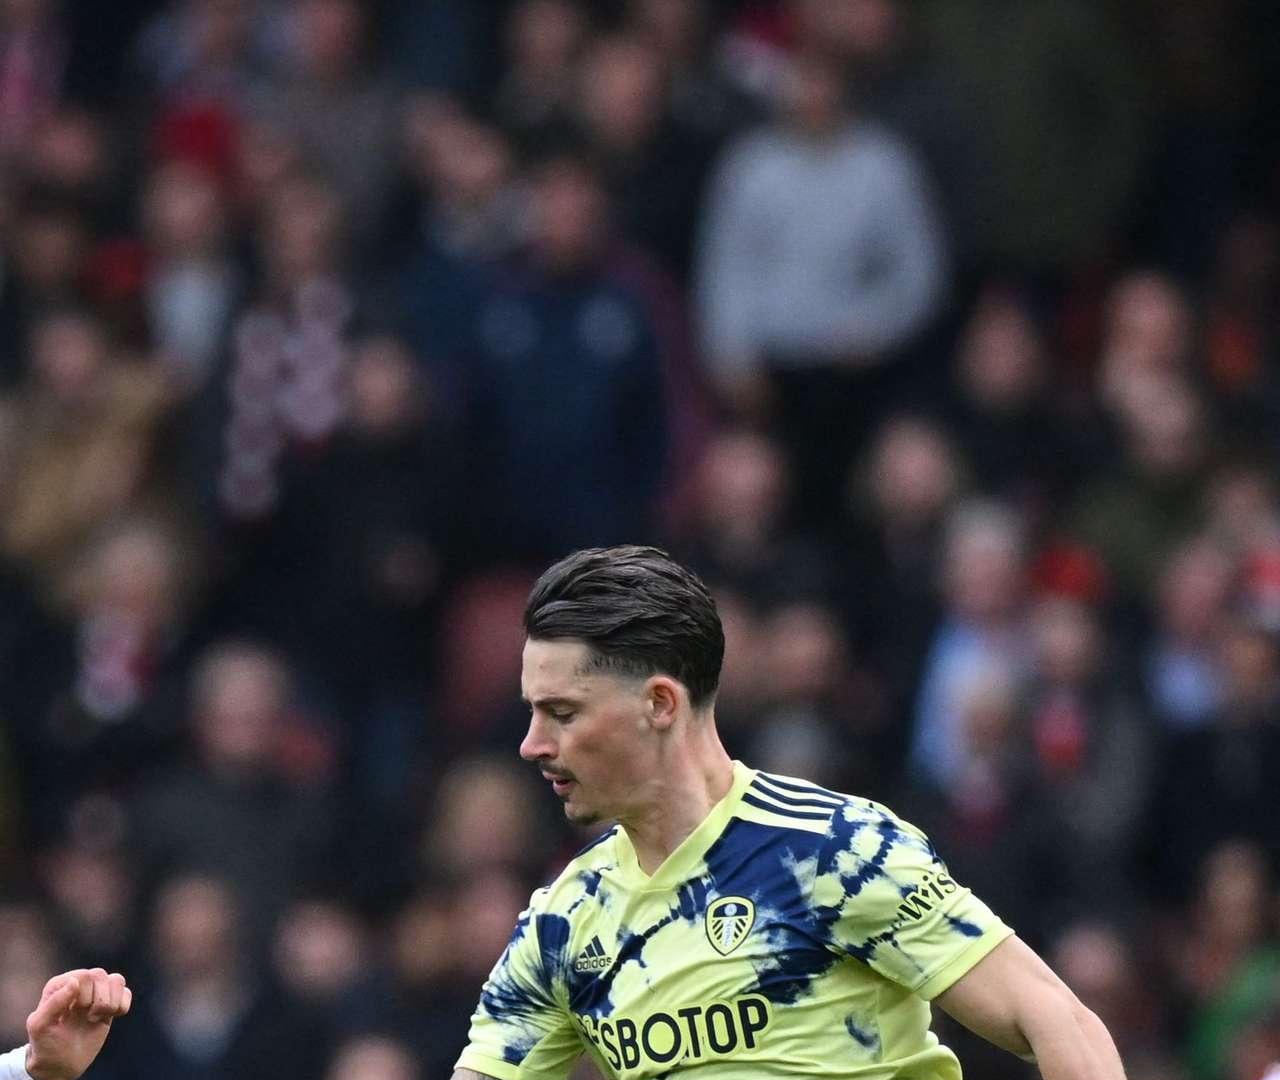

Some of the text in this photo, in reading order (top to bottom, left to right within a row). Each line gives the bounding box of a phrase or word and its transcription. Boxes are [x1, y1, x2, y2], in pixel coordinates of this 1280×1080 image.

[898, 872, 957, 920] wis
[575, 955, 612, 971] adidas
[600, 998, 769, 1071] SBOTOP
